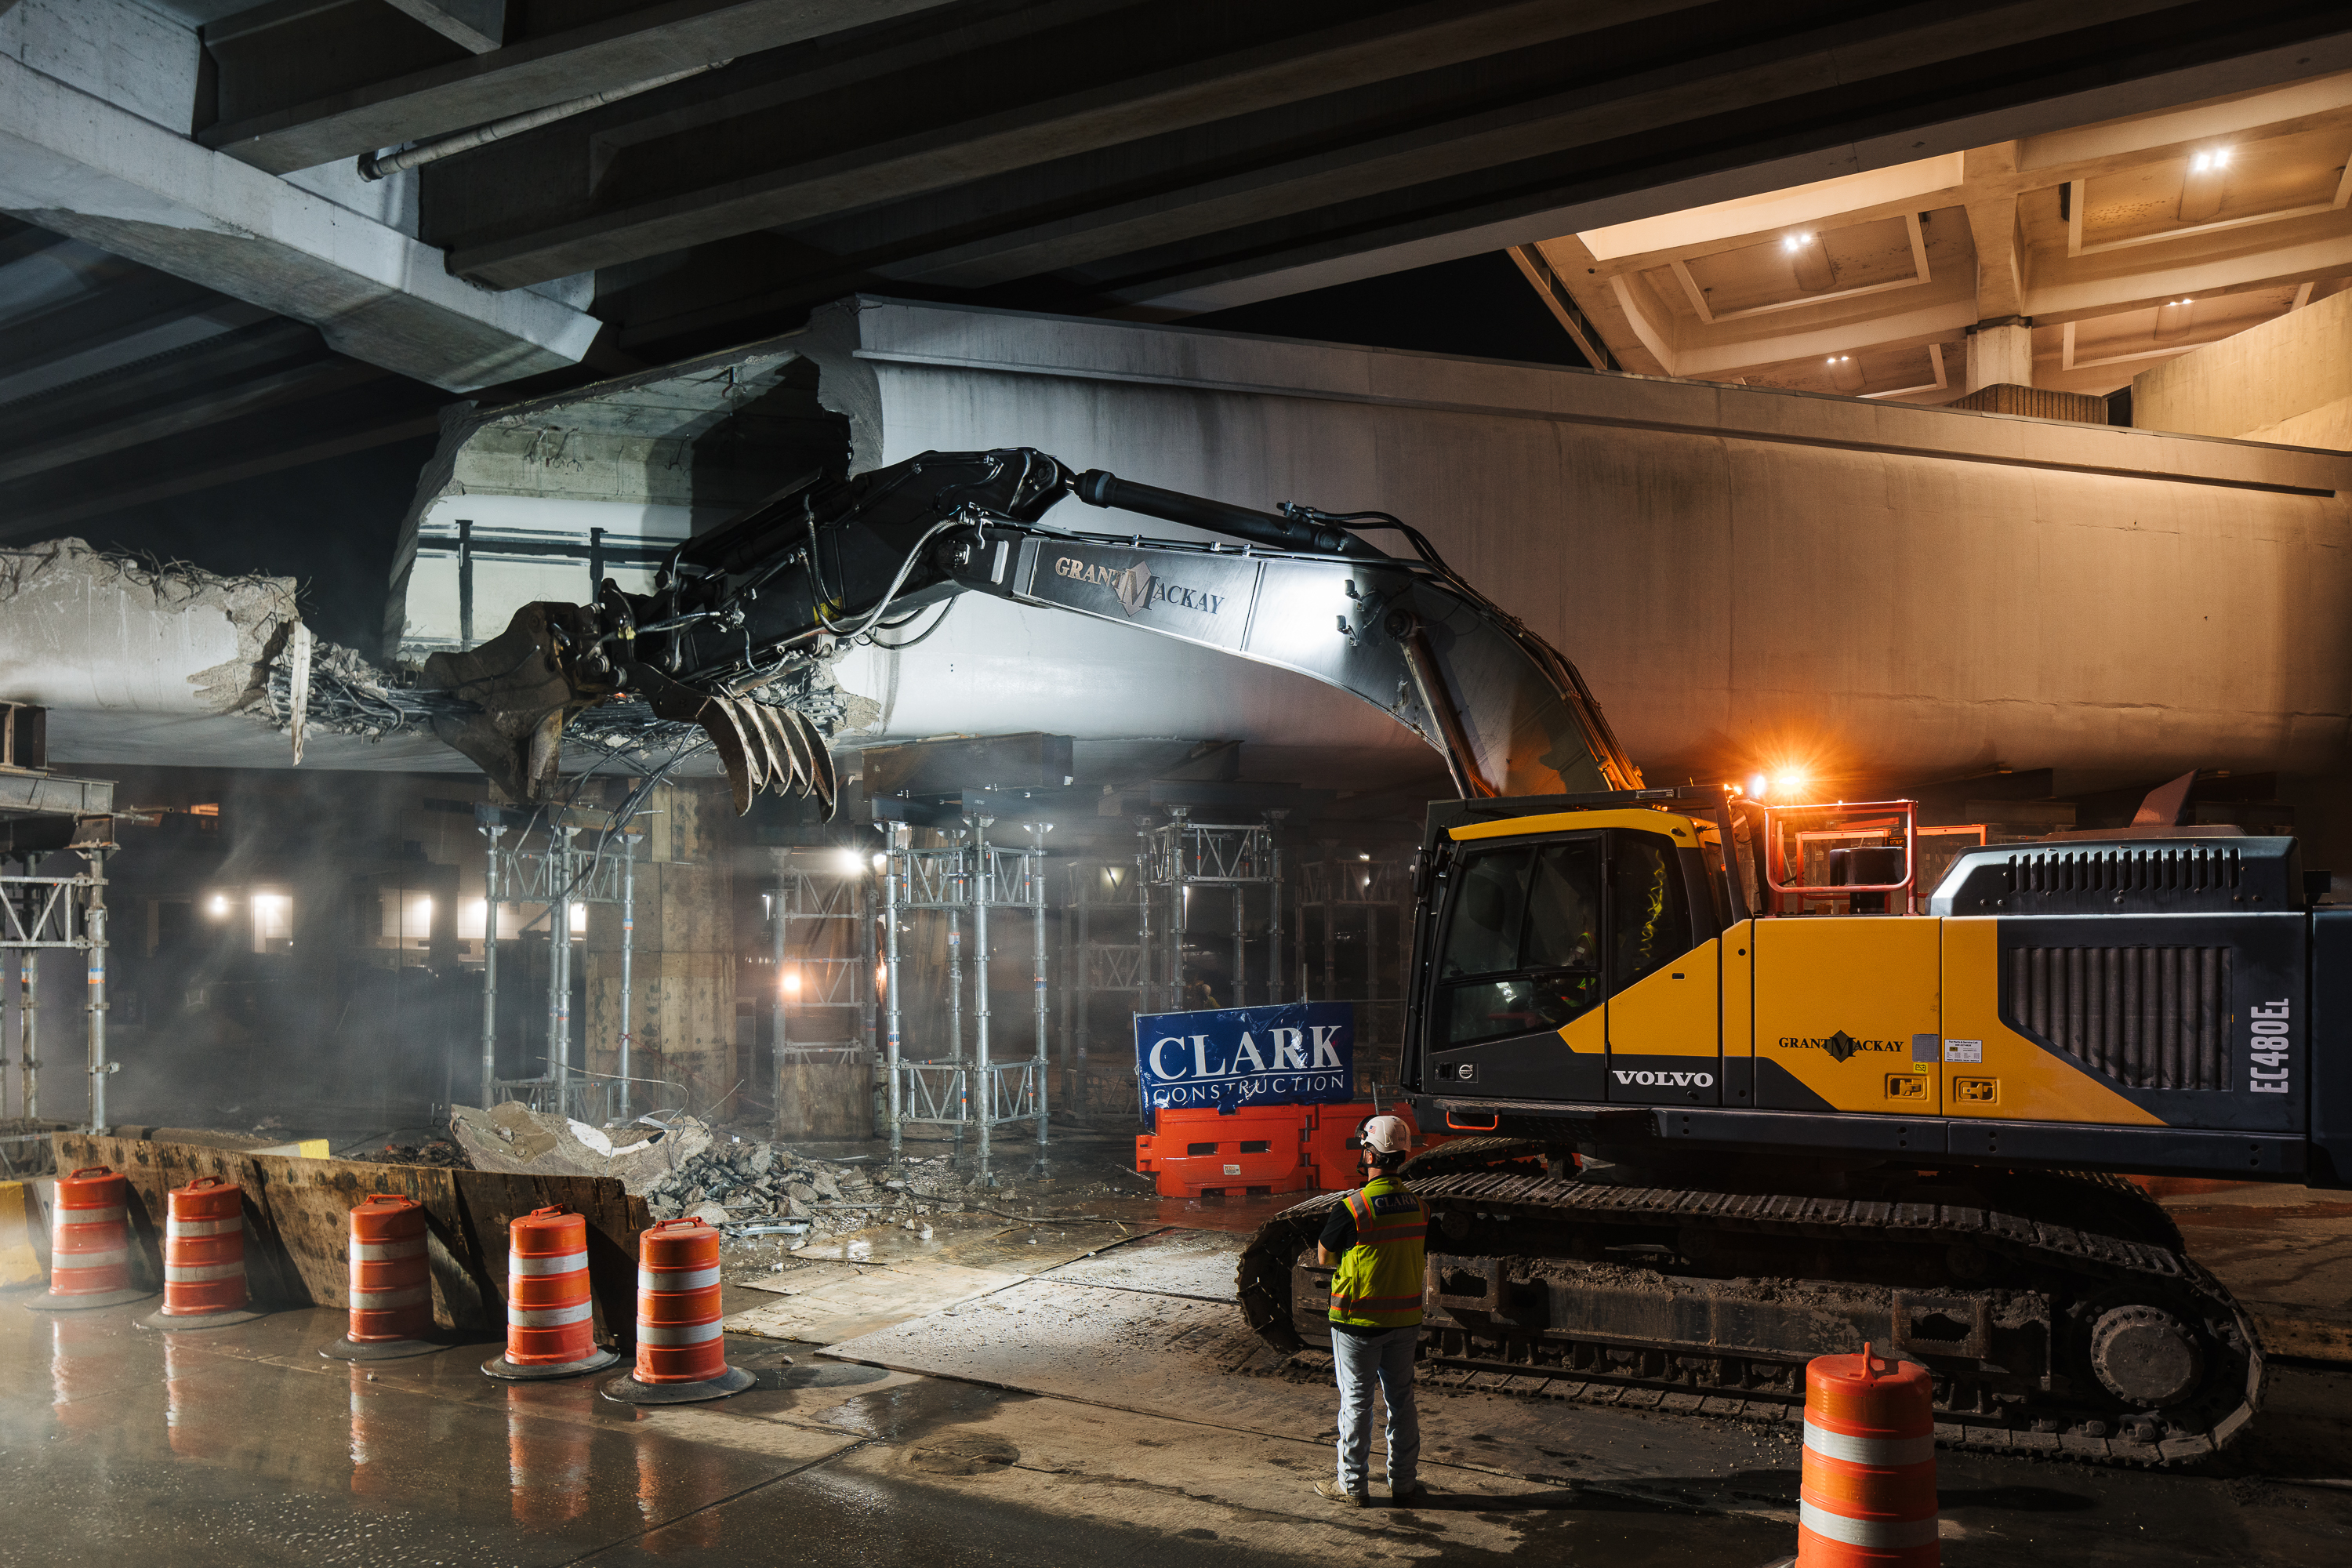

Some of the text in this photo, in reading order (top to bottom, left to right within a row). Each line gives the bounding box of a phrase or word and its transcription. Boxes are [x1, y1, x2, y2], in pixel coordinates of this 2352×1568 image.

[1055, 557, 1225, 615] GRANT MACKAY
[1149, 1025, 1343, 1080] CLARK
[1778, 1037, 1831, 1049] GRANT
[1828, 1036, 1904, 1058] MACKAY
[2250, 998, 2289, 1094] EC480EL
[1153, 1075, 1344, 1104] CONSTRUCTION
[1612, 1070, 1714, 1087] VOLVO
[1374, 1195, 1417, 1208] CLARK
